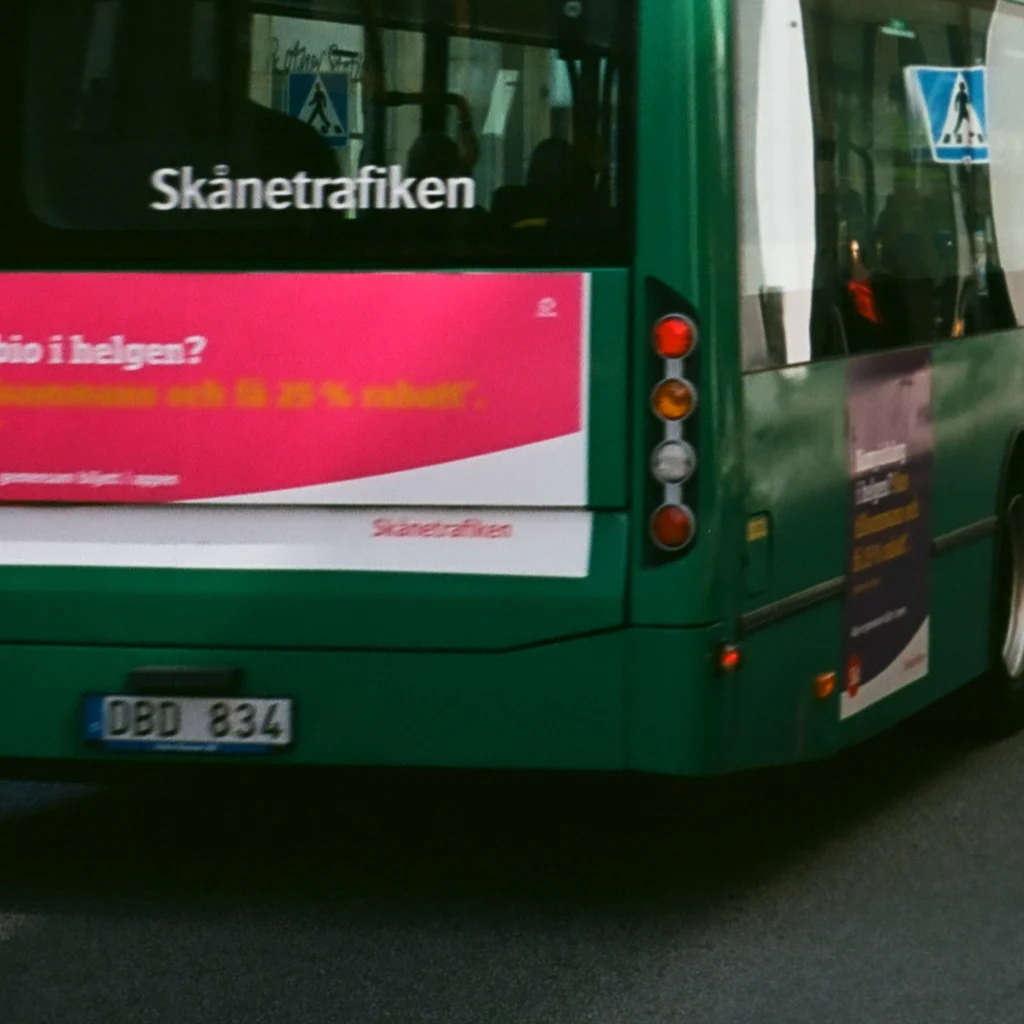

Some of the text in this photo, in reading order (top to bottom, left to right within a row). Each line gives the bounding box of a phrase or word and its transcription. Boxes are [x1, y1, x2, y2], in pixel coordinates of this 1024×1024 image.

[151, 164, 476, 210] Skånetrafiken
[48, 334, 64, 364] i
[69, 334, 208, 371] helgen?
[371, 518, 513, 539] Skånetrafiken
[109, 699, 284, 739] DBD 834
